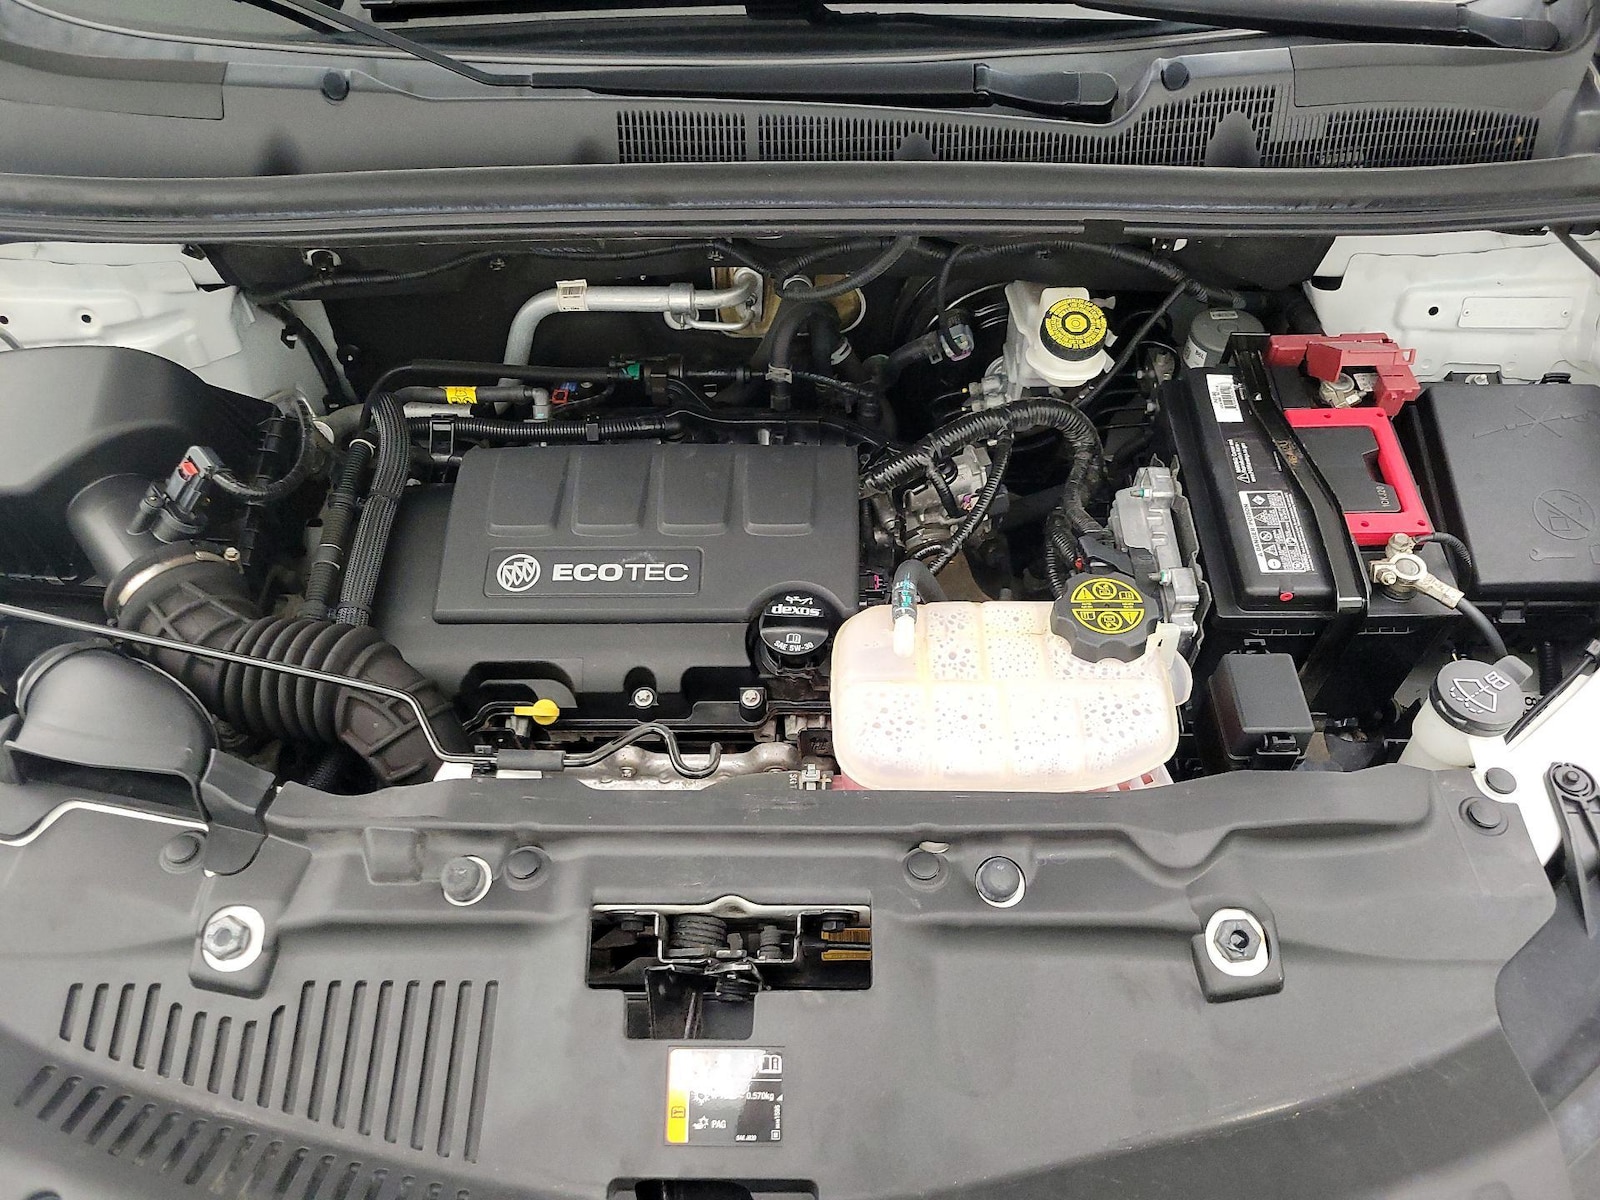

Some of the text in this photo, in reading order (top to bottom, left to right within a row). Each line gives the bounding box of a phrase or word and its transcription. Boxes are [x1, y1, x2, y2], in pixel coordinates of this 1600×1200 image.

[552, 563, 690, 582] ECOTEC
[771, 603, 822, 617] dexos
[774, 640, 814, 652] SAE 5W-30
[746, 1091, 775, 1102] 0.570kg
[711, 1119, 727, 1129] PAG
